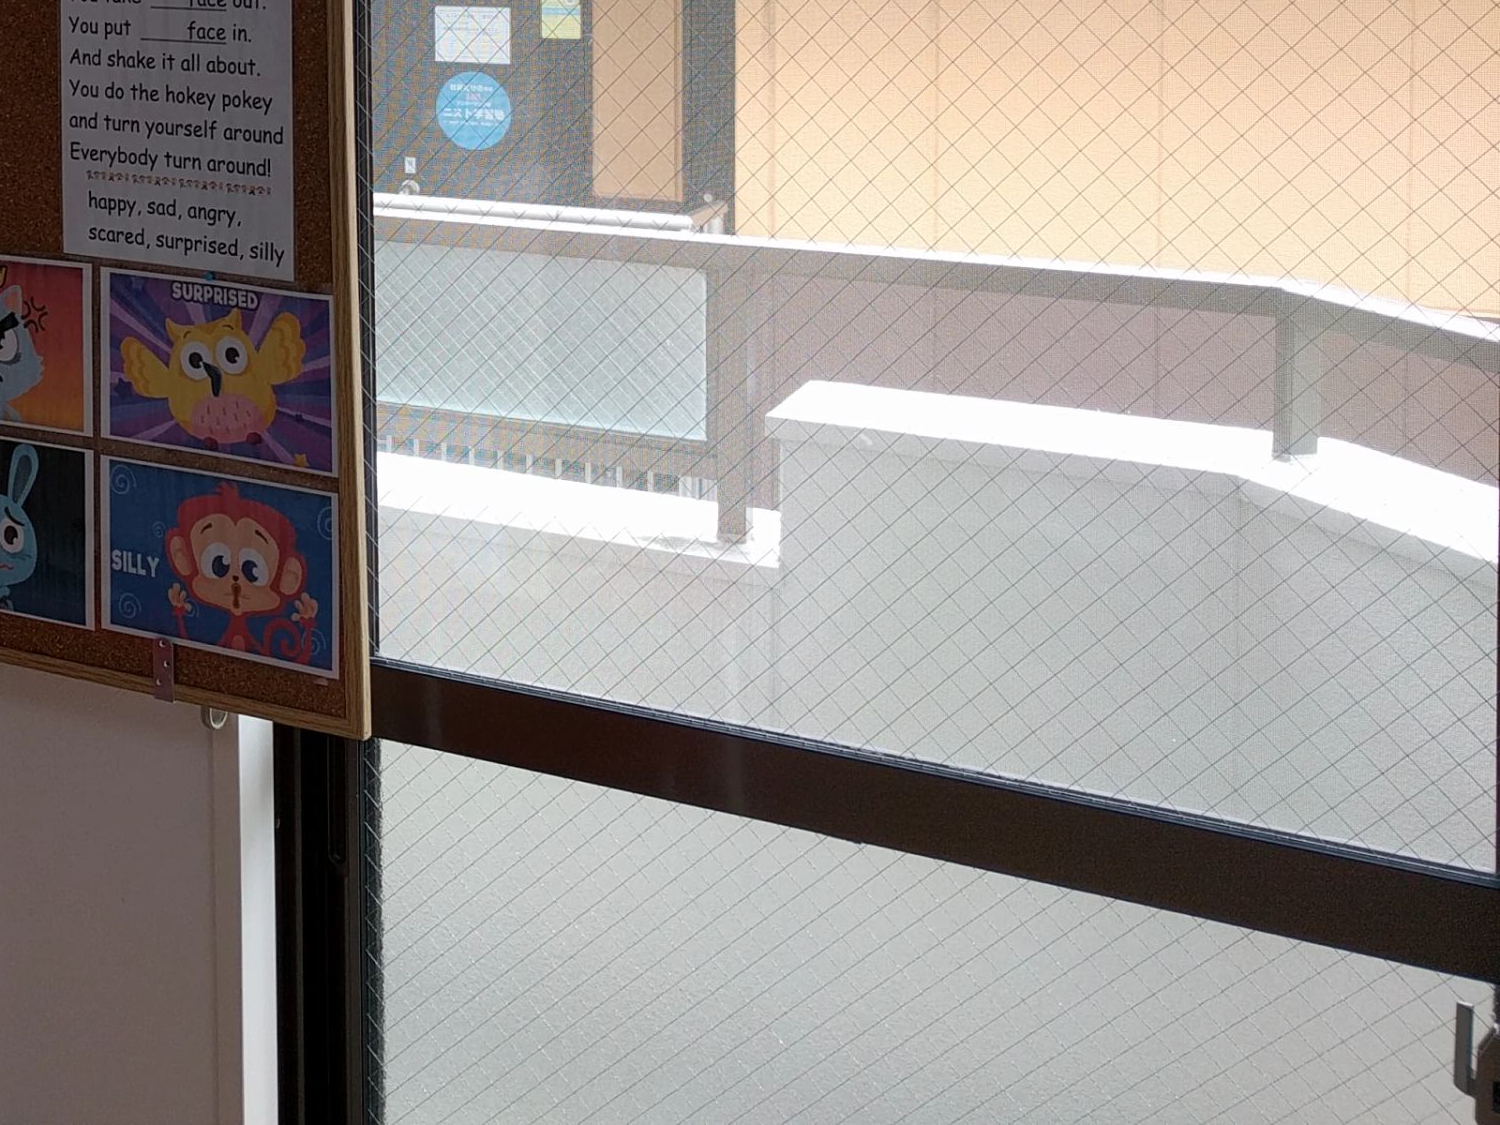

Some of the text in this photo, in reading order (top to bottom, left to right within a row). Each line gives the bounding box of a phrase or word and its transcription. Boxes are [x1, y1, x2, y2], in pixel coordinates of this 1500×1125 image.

[70, 49, 260, 76] And shake it all about.
[69, 79, 272, 115] You do the hokey pokey
[70, 113, 283, 145] and turn yourself around
[70, 142, 270, 177] Everybody turn around!
[89, 191, 241, 228] happy, sad, angry,
[88, 227, 284, 267] scared, surprised, silly
[172, 281, 259, 311] SURPRISED
[111, 549, 160, 577] SILLY
